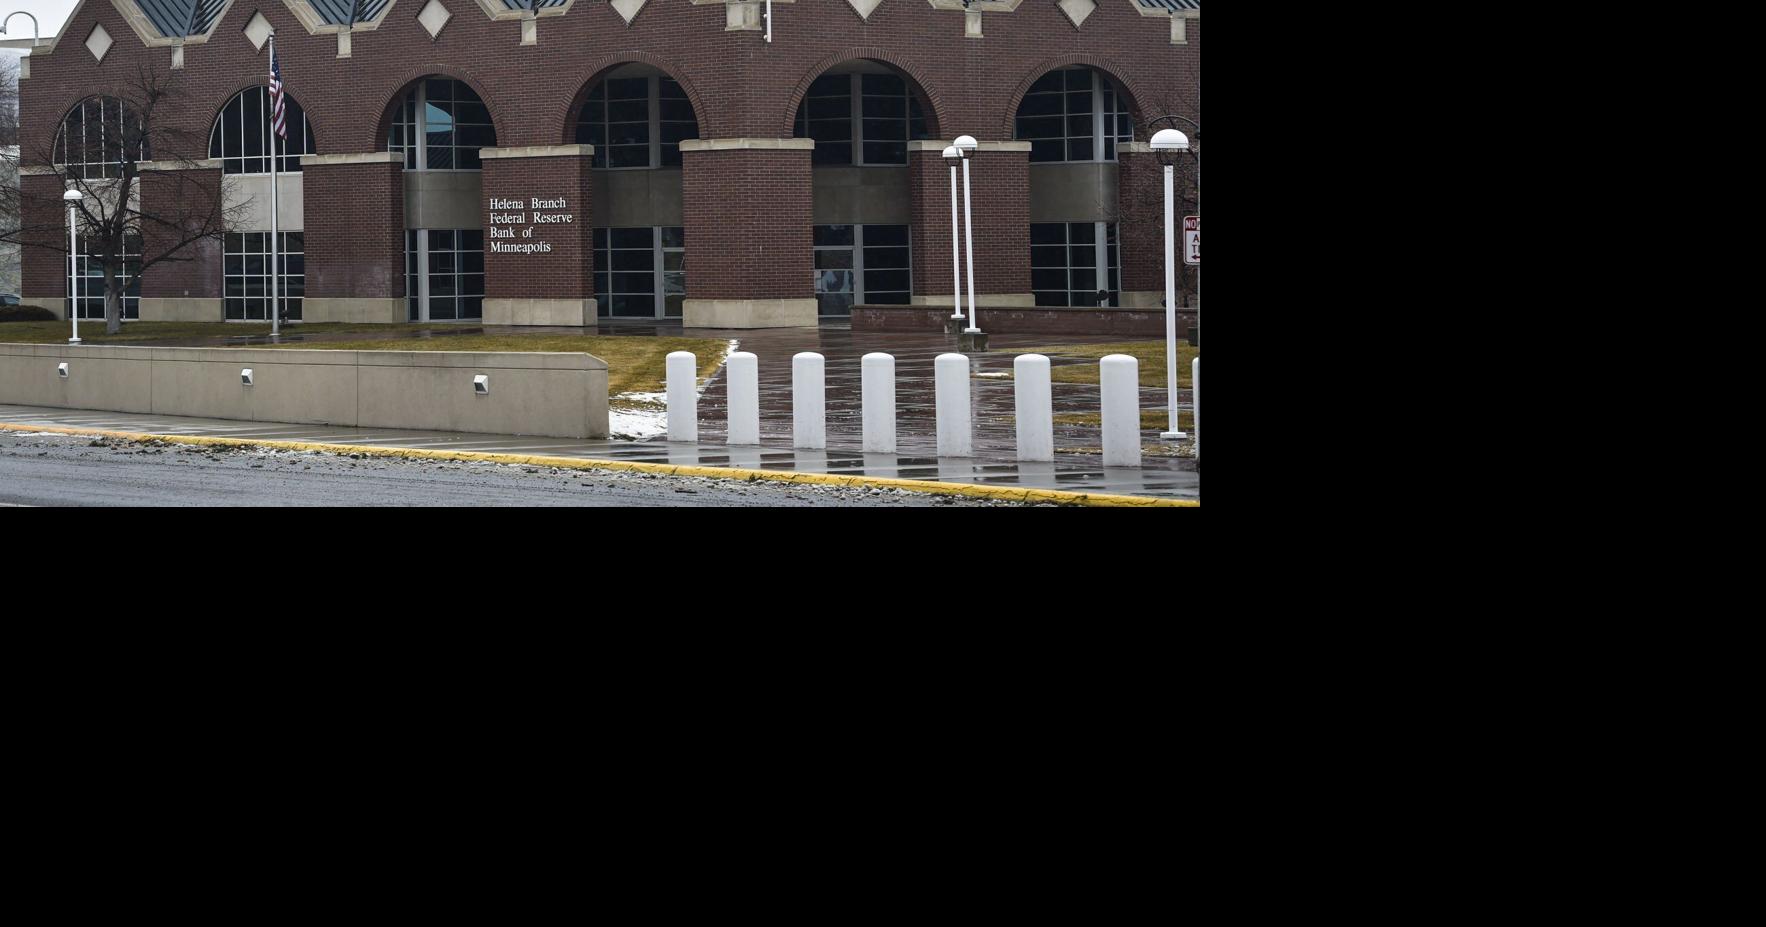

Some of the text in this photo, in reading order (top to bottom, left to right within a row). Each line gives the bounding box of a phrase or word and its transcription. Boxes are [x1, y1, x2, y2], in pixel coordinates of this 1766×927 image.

[490, 197, 566, 209] Helena Branch
[490, 212, 573, 223] Federal Reserve
[490, 226, 534, 238] Bank of
[490, 241, 551, 254] Minneapolis
